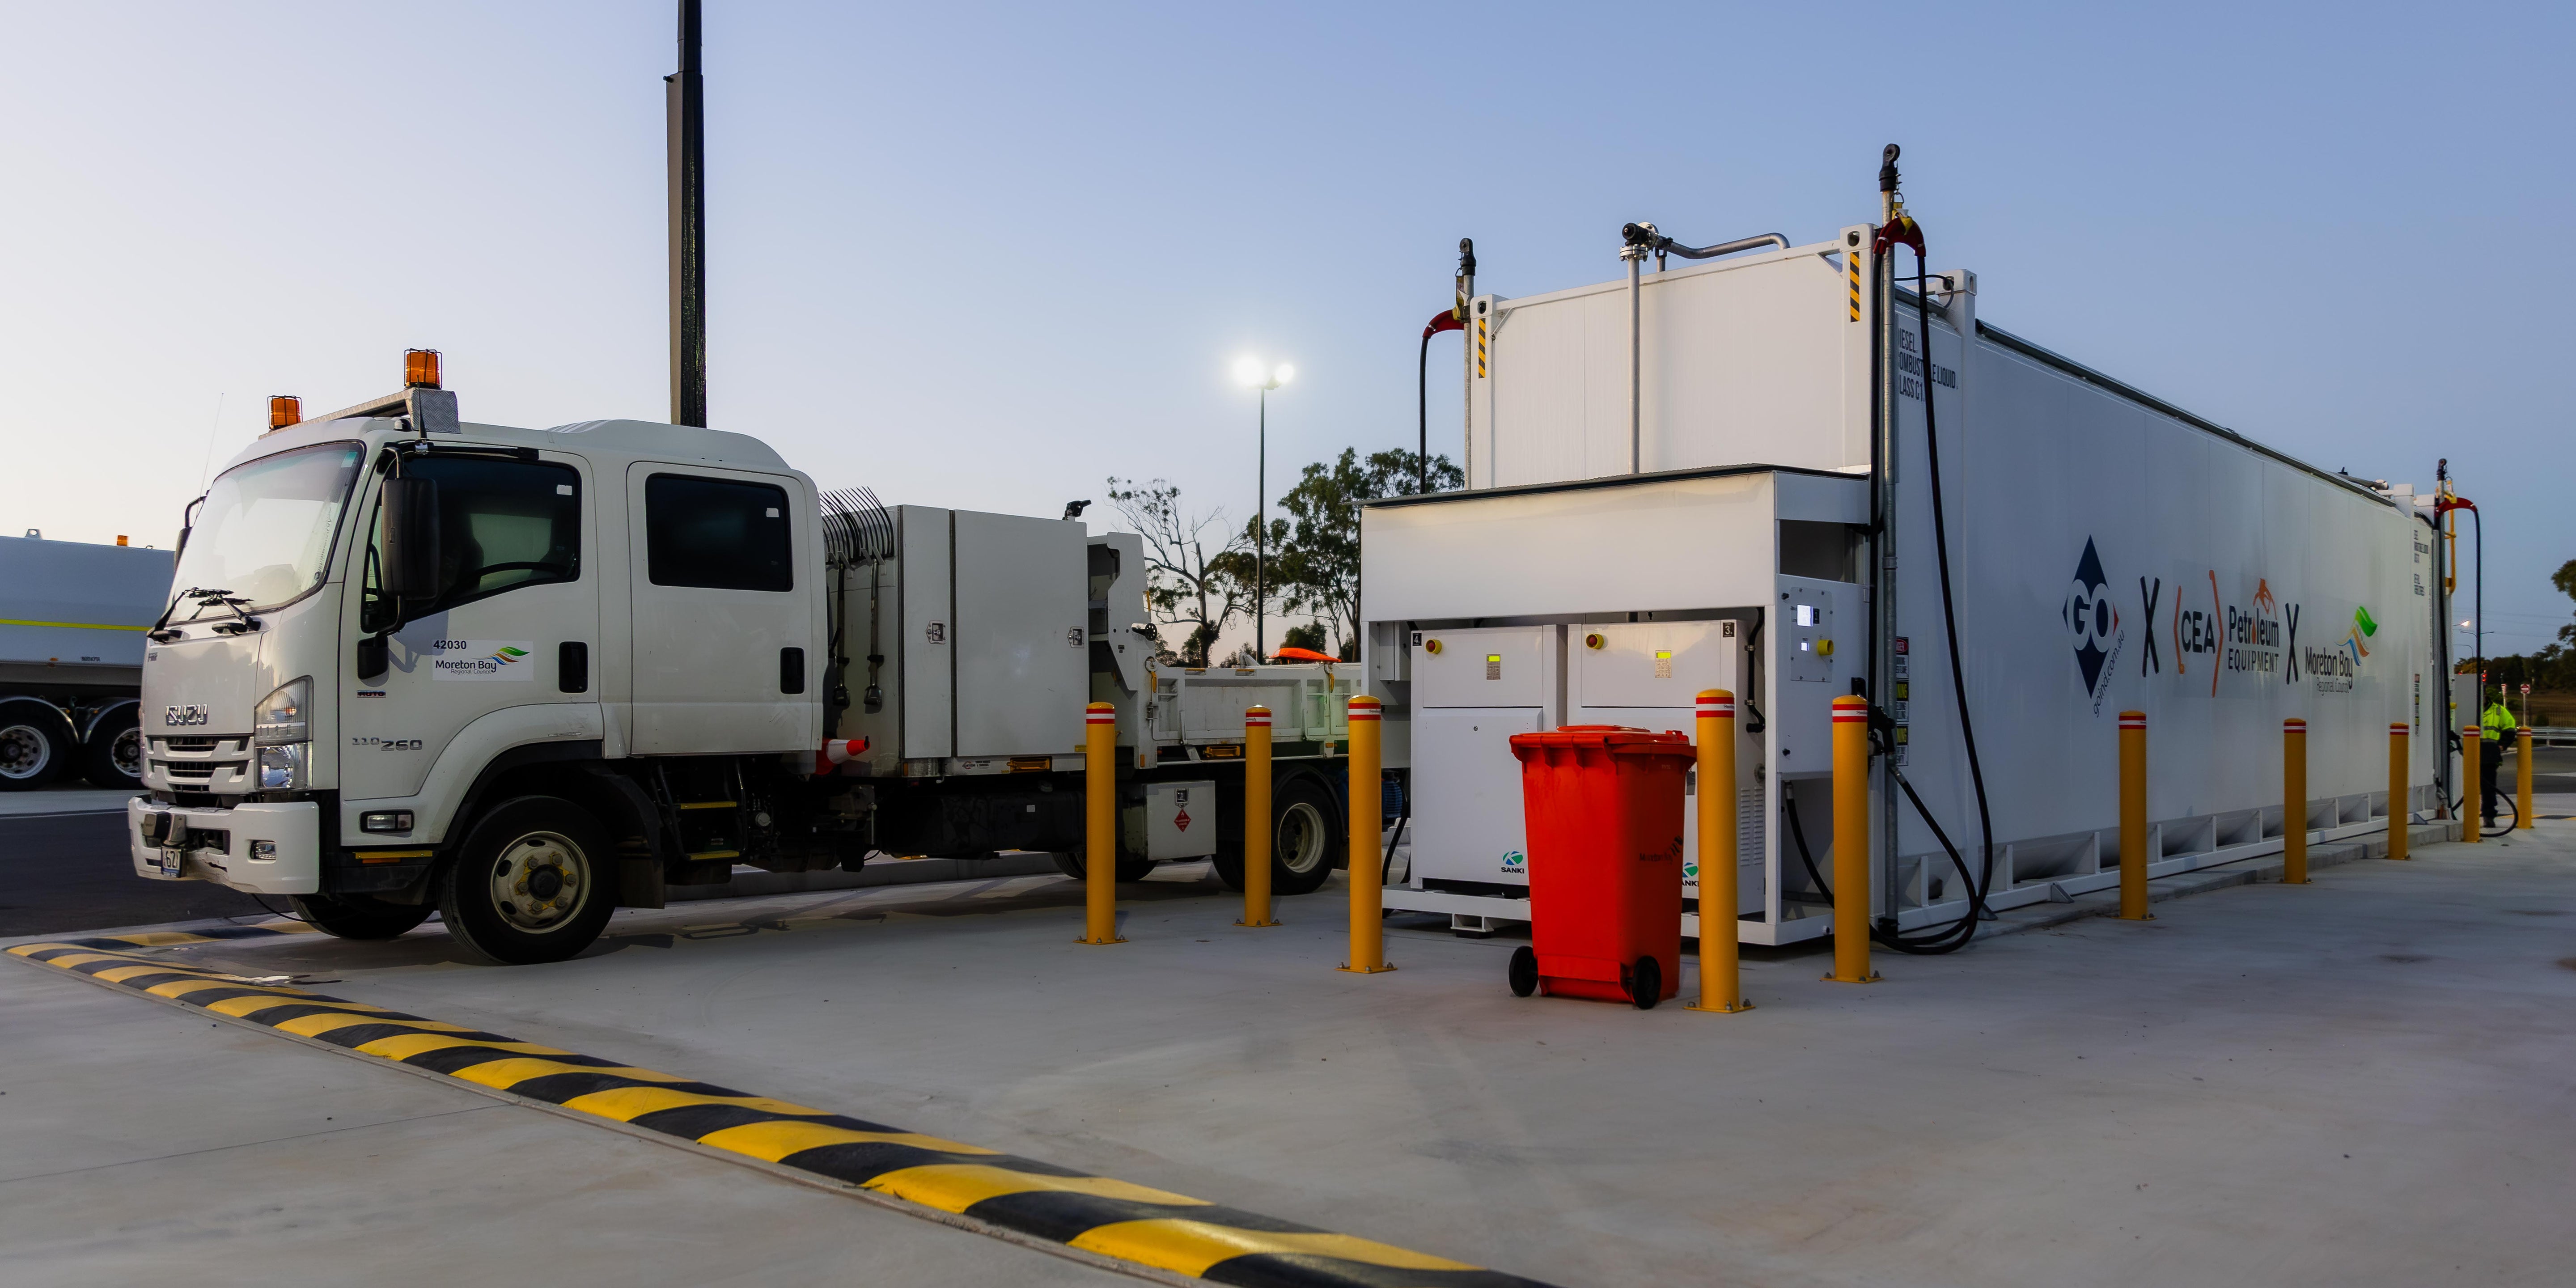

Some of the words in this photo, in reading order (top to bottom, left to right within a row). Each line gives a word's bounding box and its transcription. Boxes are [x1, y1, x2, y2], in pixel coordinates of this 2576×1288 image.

[1899, 328, 1918, 353] IESEL.
[1899, 374, 1914, 398] LASS
[2067, 579, 2114, 653] GO
[2140, 576, 2161, 678] X
[2229, 605, 2279, 648] Petroleum
[433, 640, 466, 649] 42030
[2285, 602, 2299, 685] X
[435, 660, 475, 669] Moreton
[478, 661, 497, 673] Bay
[2228, 648, 2279, 673] EQUIPMENT
[2305, 646, 2337, 676] Moreton
[2339, 650, 2353, 690] Bay
[2093, 629, 2125, 718] goind.com.au
[165, 703, 208, 726] ISUZU
[381, 739, 422, 751] 260
